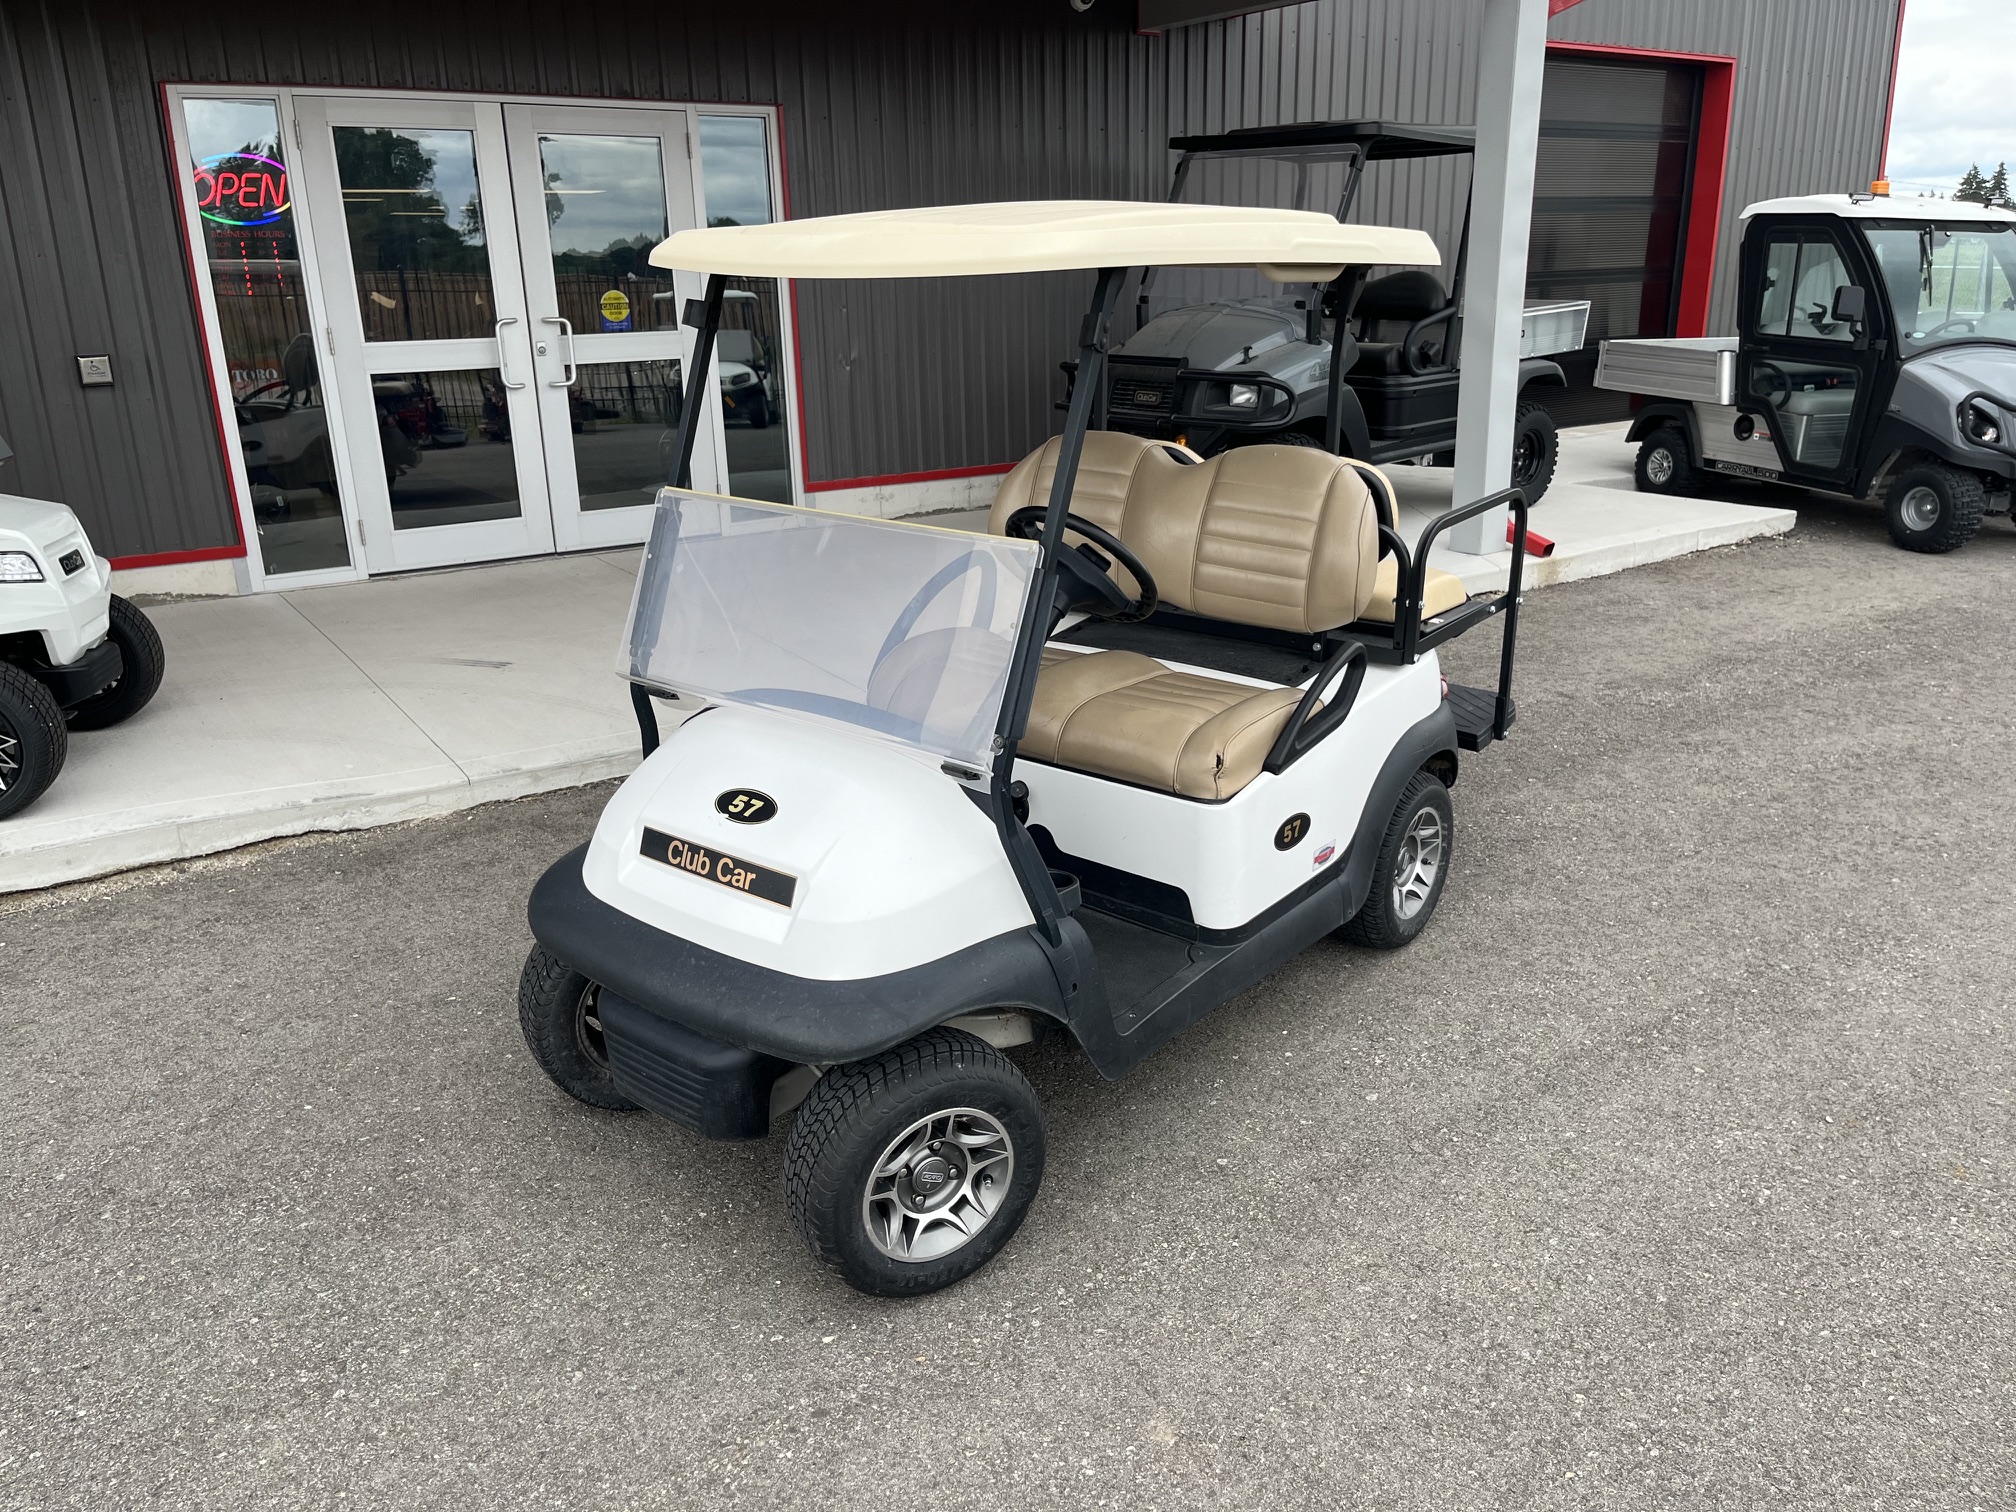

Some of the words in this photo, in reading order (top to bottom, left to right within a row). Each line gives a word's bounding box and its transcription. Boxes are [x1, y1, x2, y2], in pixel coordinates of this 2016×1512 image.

[194, 172, 286, 207] OPEN
[210, 230, 251, 239] BUSINESS
[254, 230, 286, 239] HOURS
[231, 368, 278, 383] TORO
[1715, 461, 1757, 476] CARRYALL
[1757, 468, 1779, 480] 500
[728, 794, 765, 818] 57
[1283, 819, 1302, 843] 57
[667, 840, 711, 875] Club
[716, 857, 757, 890] Car
